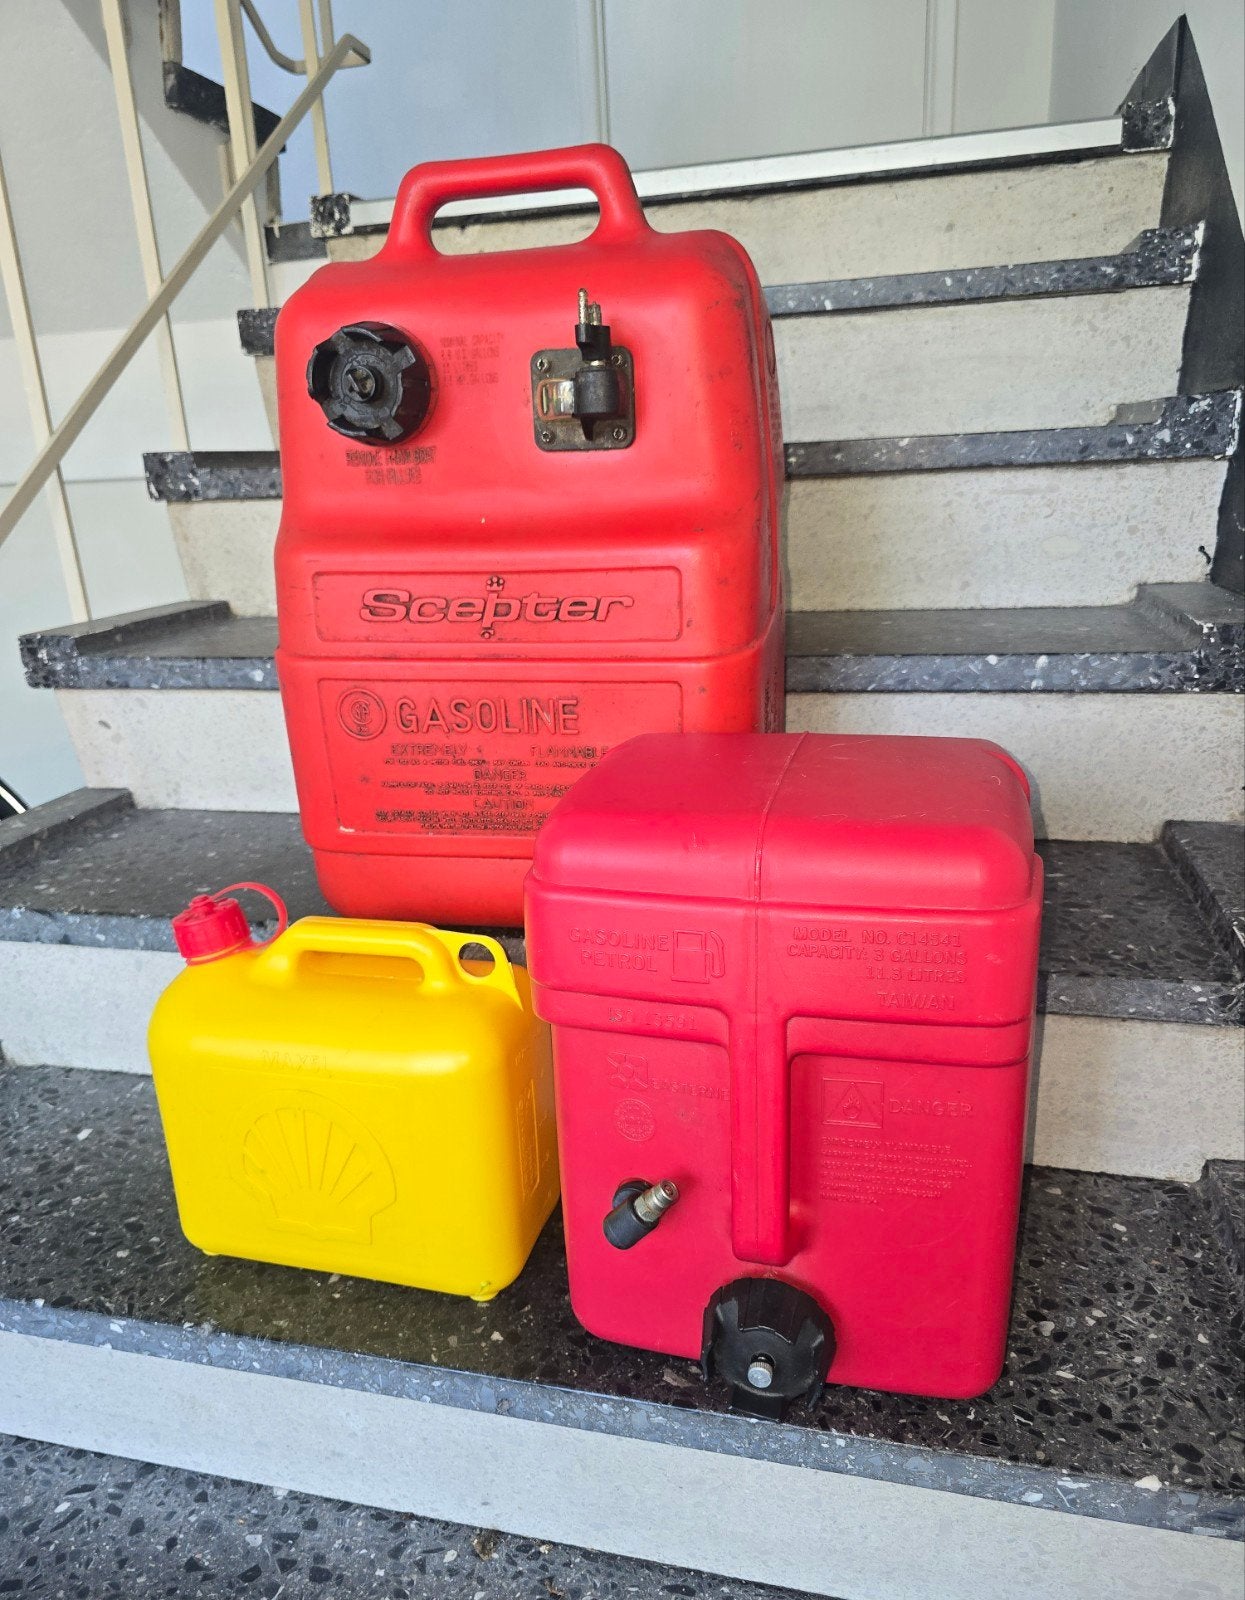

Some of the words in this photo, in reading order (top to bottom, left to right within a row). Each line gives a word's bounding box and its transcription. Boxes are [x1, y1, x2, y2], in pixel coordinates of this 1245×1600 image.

[359, 587, 635, 629] Scepter
[394, 695, 580, 737] GASOLINE
[391, 743, 468, 757] EXTREMELY
[474, 768, 527, 782] DANGER
[568, 927, 670, 952] GASOLINE
[792, 926, 853, 943] MODEL
[861, 929, 892, 946] NO.
[580, 949, 658, 973] PETROL
[786, 943, 867, 961] CAPACITY:
[873, 949, 885, 963] 3
[889, 949, 968, 966] GALLONS
[907, 968, 968, 984] LITRES
[877, 990, 956, 1011] TAIWAN
[888, 1098, 974, 1117] DANGER
